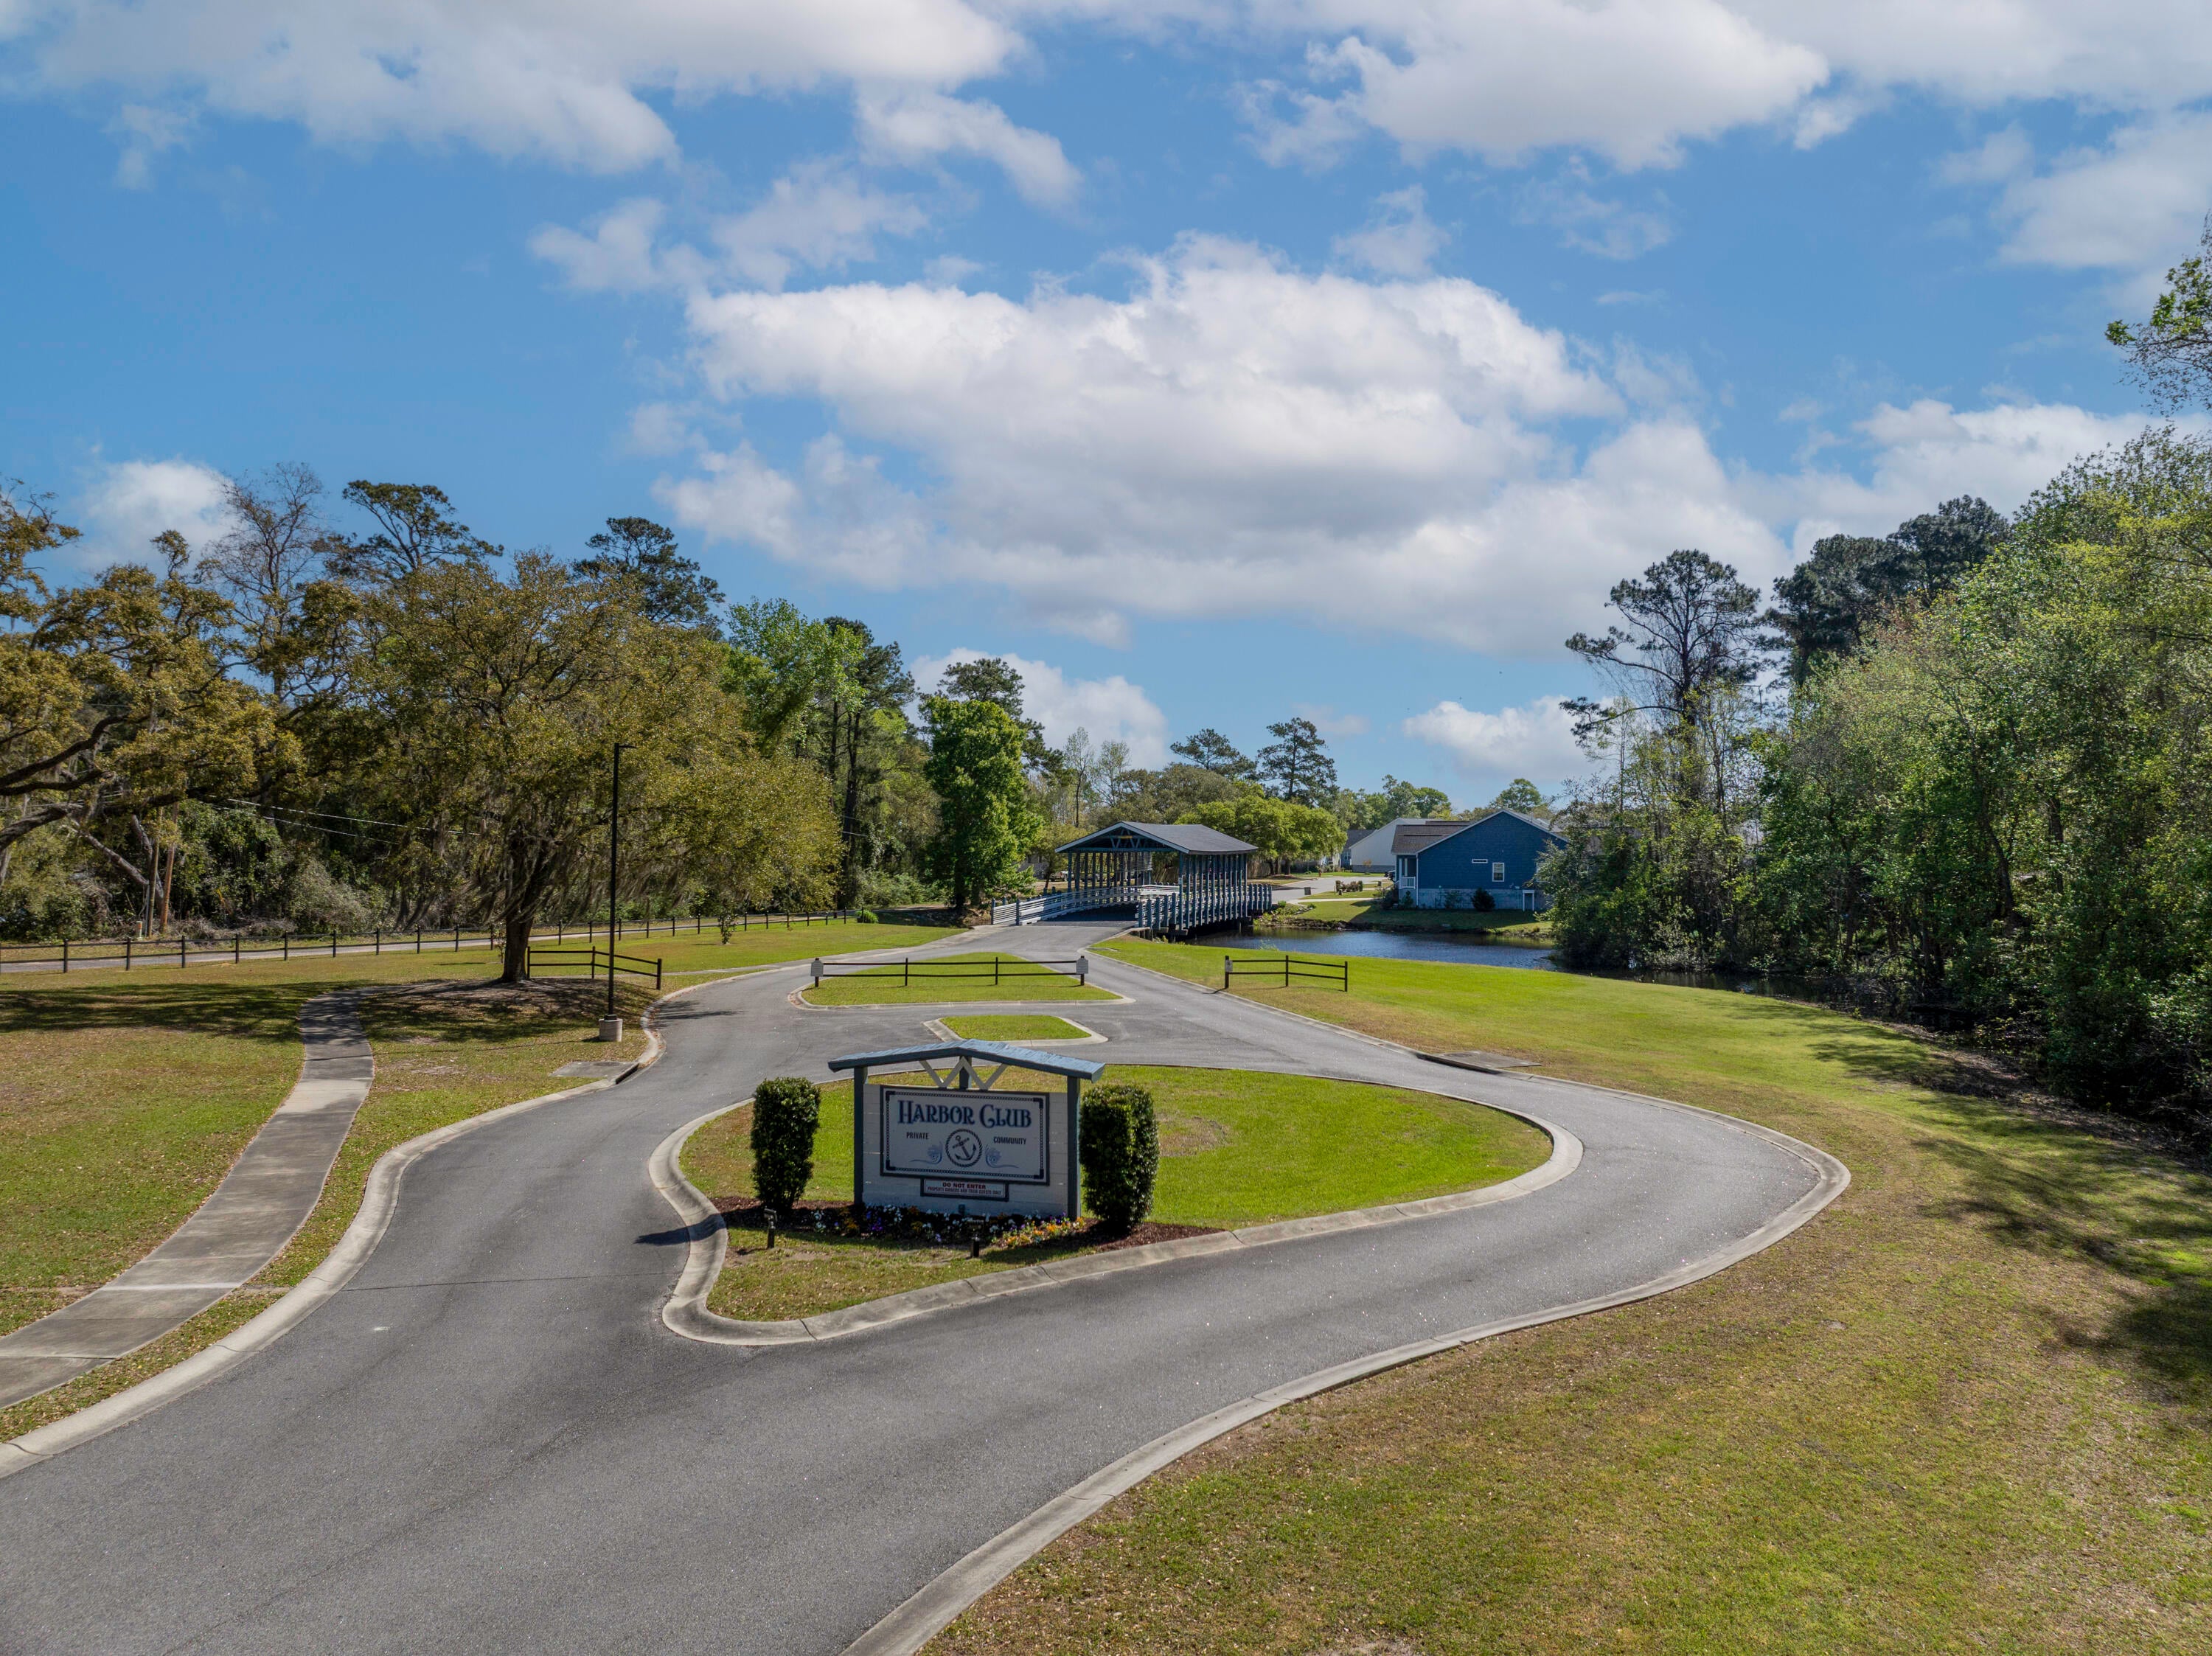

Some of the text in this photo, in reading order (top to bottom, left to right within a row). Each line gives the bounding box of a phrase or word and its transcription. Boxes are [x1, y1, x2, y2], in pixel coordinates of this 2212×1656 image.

[897, 1099, 1032, 1128] HARBOR CLUB
[906, 1132, 929, 1140] PRIVATE
[993, 1136, 1027, 1145] COMMUNITY
